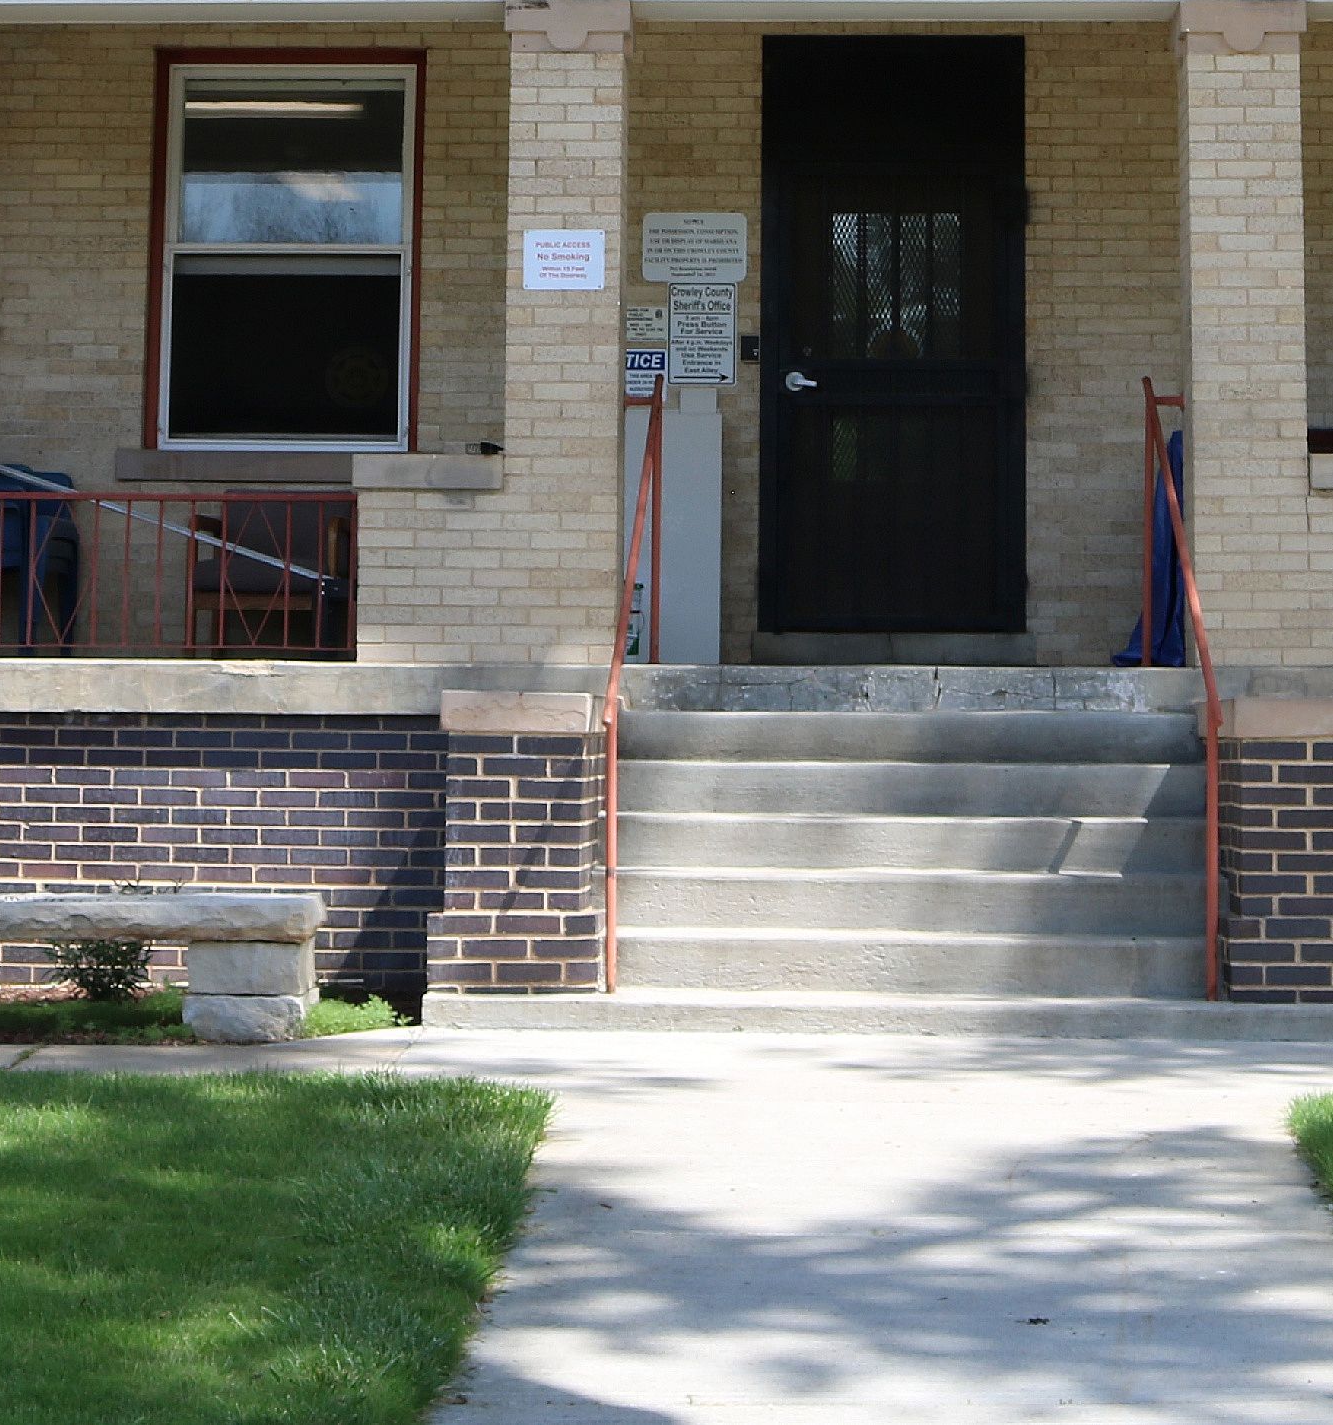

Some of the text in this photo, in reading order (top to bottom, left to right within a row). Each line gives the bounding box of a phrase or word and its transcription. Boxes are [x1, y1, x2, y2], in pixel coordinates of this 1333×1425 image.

[535, 241, 591, 249] PUBLIC ACCESS
[537, 253, 590, 262] No Smoking
[671, 286, 733, 300] Crowley County
[673, 300, 732, 311] Sheriff's Office
[626, 353, 663, 368] TICE
